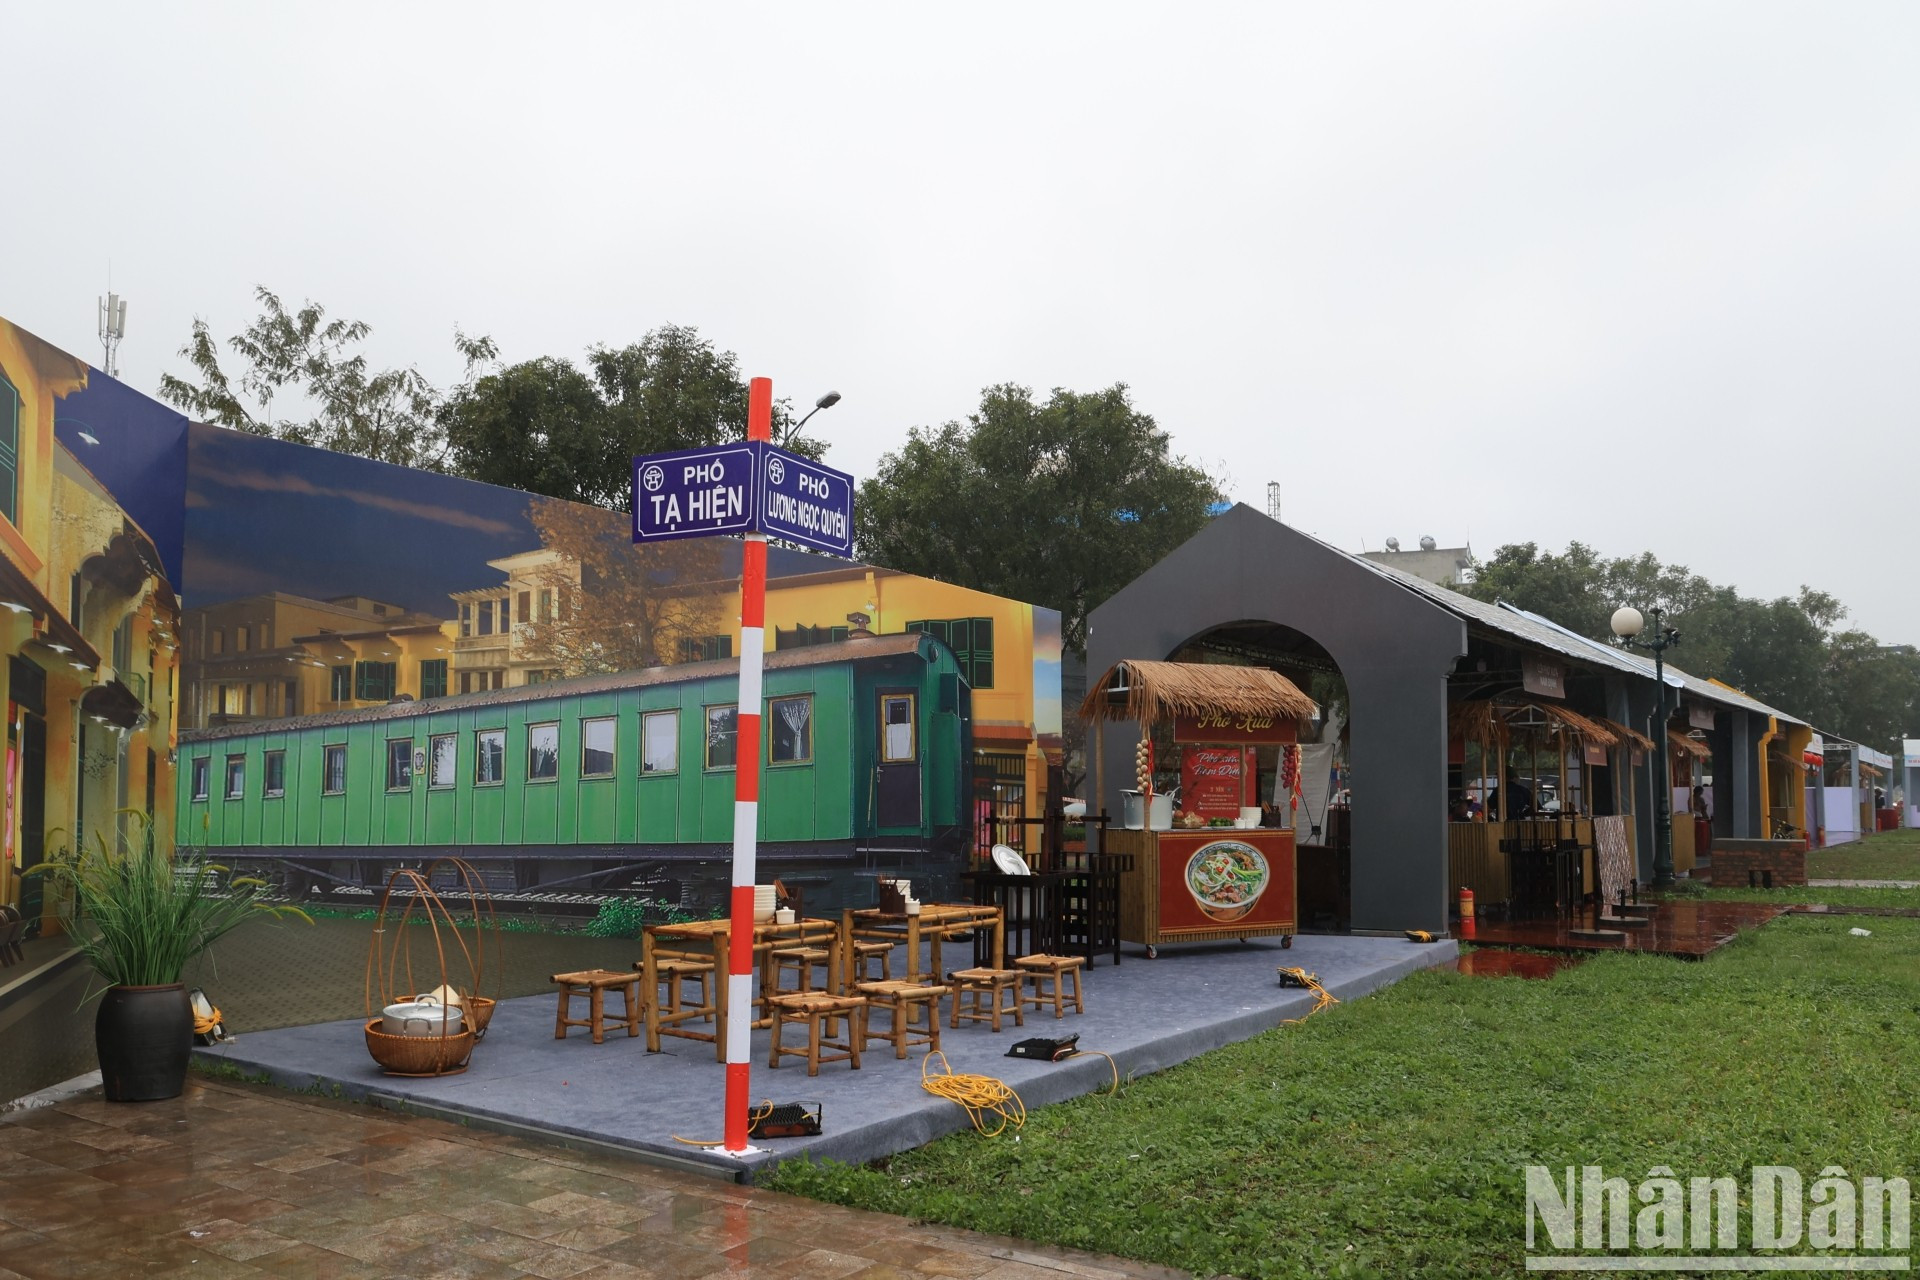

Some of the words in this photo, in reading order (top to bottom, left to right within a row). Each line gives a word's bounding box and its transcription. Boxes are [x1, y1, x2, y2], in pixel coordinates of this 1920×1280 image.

[683, 458, 724, 485] PHỐ
[799, 472, 829, 499] PHỐ
[650, 493, 682, 531] TẠ
[688, 484, 743, 526] HIỆN
[768, 490, 797, 524] LƯƠNG
[797, 500, 820, 536] NGỌC
[820, 507, 846, 539] QUYẾN
